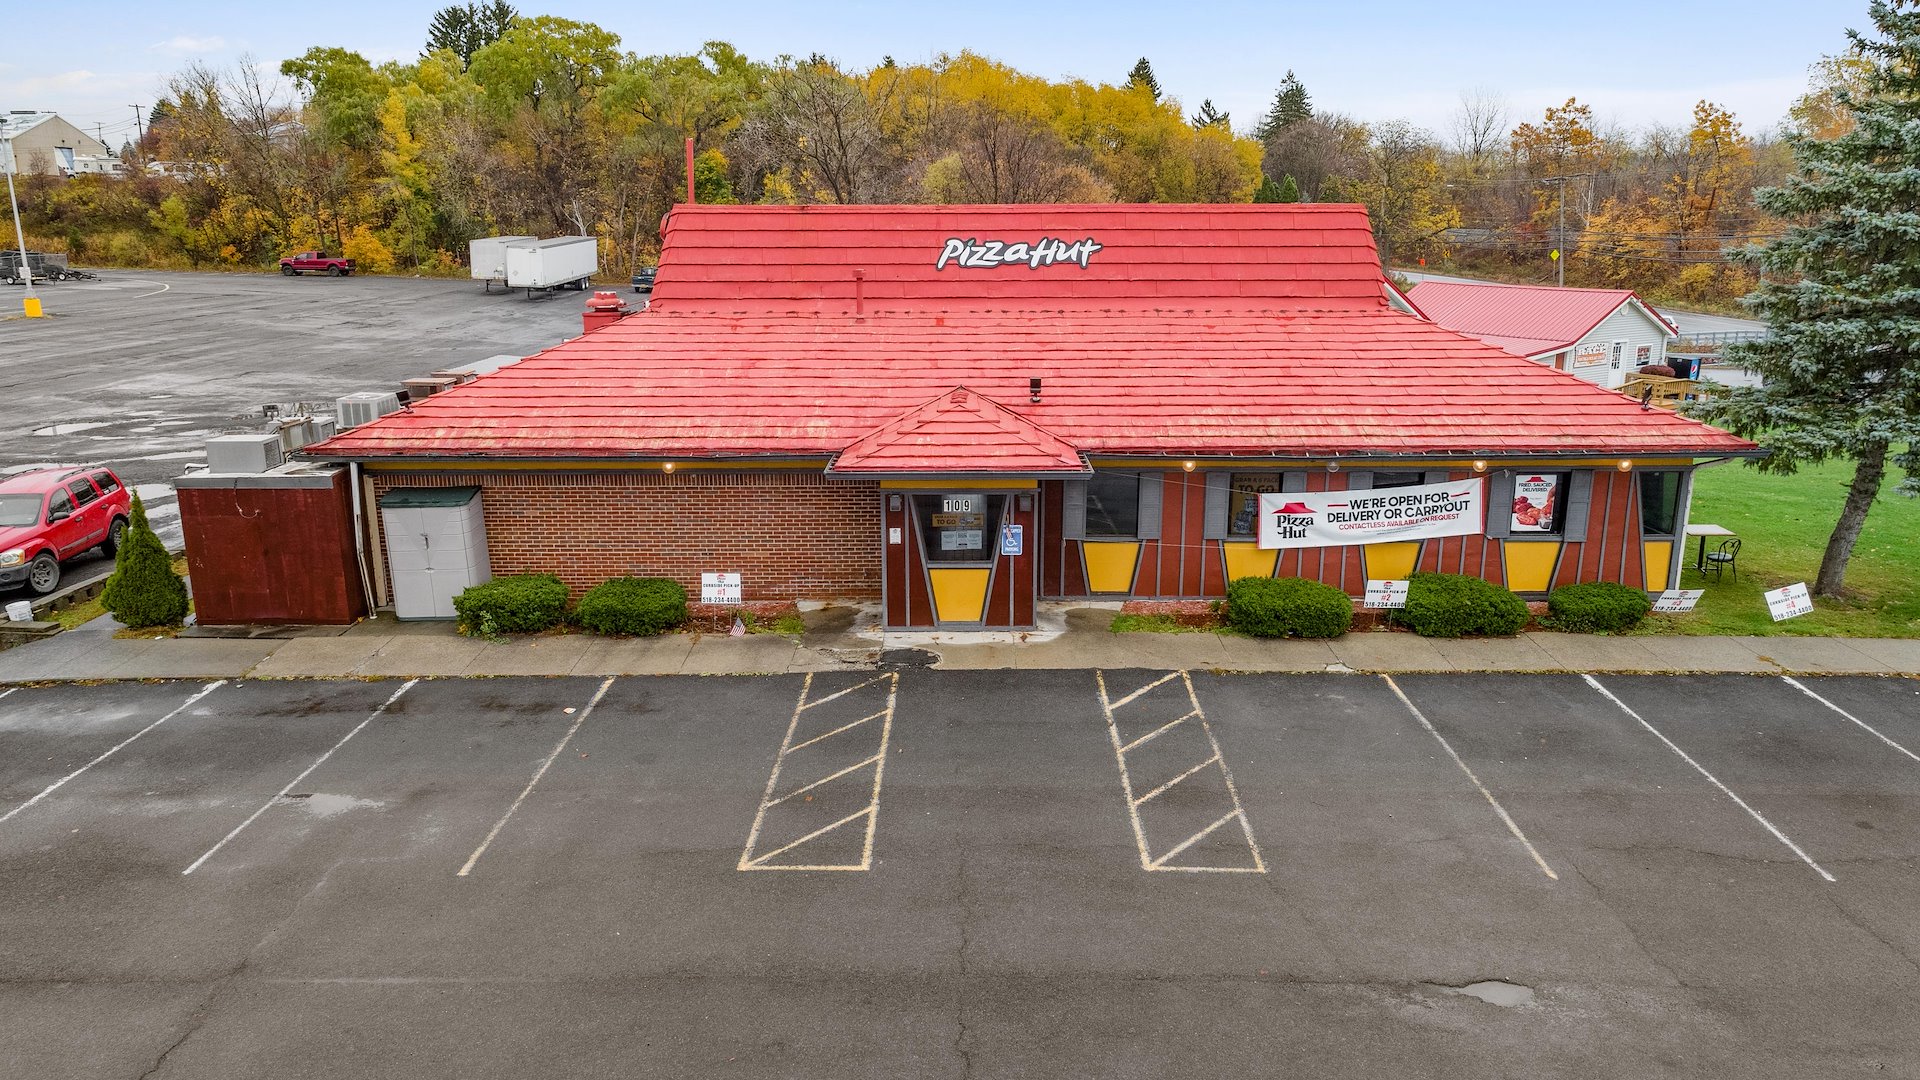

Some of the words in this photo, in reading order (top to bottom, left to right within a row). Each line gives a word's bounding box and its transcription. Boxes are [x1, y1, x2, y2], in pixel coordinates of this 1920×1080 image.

[1239, 484, 1253, 493] TO
[1257, 484, 1275, 493] GO
[945, 500, 970, 511] 109
[1350, 497, 1386, 510] WE'RE
[1388, 495, 1424, 506] OPEN
[1424, 492, 1450, 504] FOR
[1327, 509, 1381, 523] DELIVERY
[1383, 508, 1403, 520] OR
[1404, 500, 1471, 518] CARRYOUT
[1276, 514, 1314, 528] Pizza
[1338, 521, 1386, 531] CONTACTLESS
[1386, 518, 1420, 528] AVAILABLE
[1430, 512, 1460, 522] REQUEST
[1277, 526, 1307, 539] Hut
[716, 588, 726, 596] #1
[1380, 593, 1391, 601] #2
[1785, 600, 1796, 609] #4
